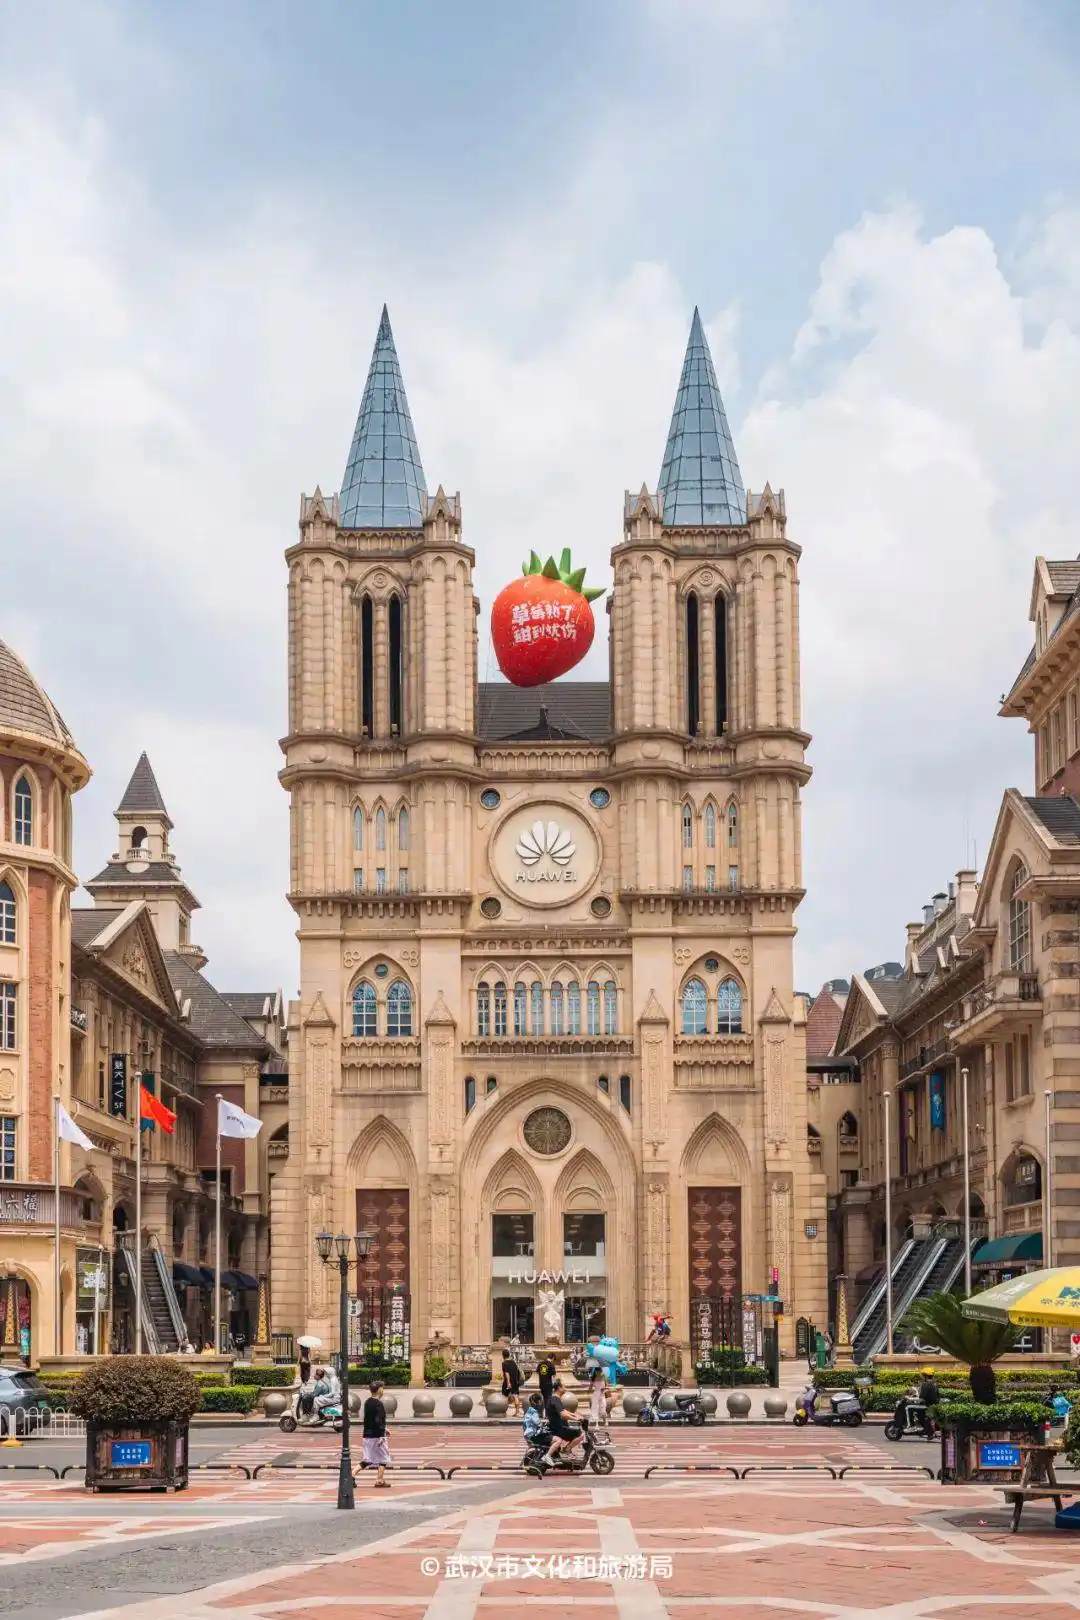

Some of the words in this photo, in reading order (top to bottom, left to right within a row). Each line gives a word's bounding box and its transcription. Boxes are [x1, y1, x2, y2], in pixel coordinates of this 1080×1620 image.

[515, 870, 577, 882] HUAWEI
[0, 1193, 37, 1211] 六福
[508, 1268, 590, 1284] HUAWEI
